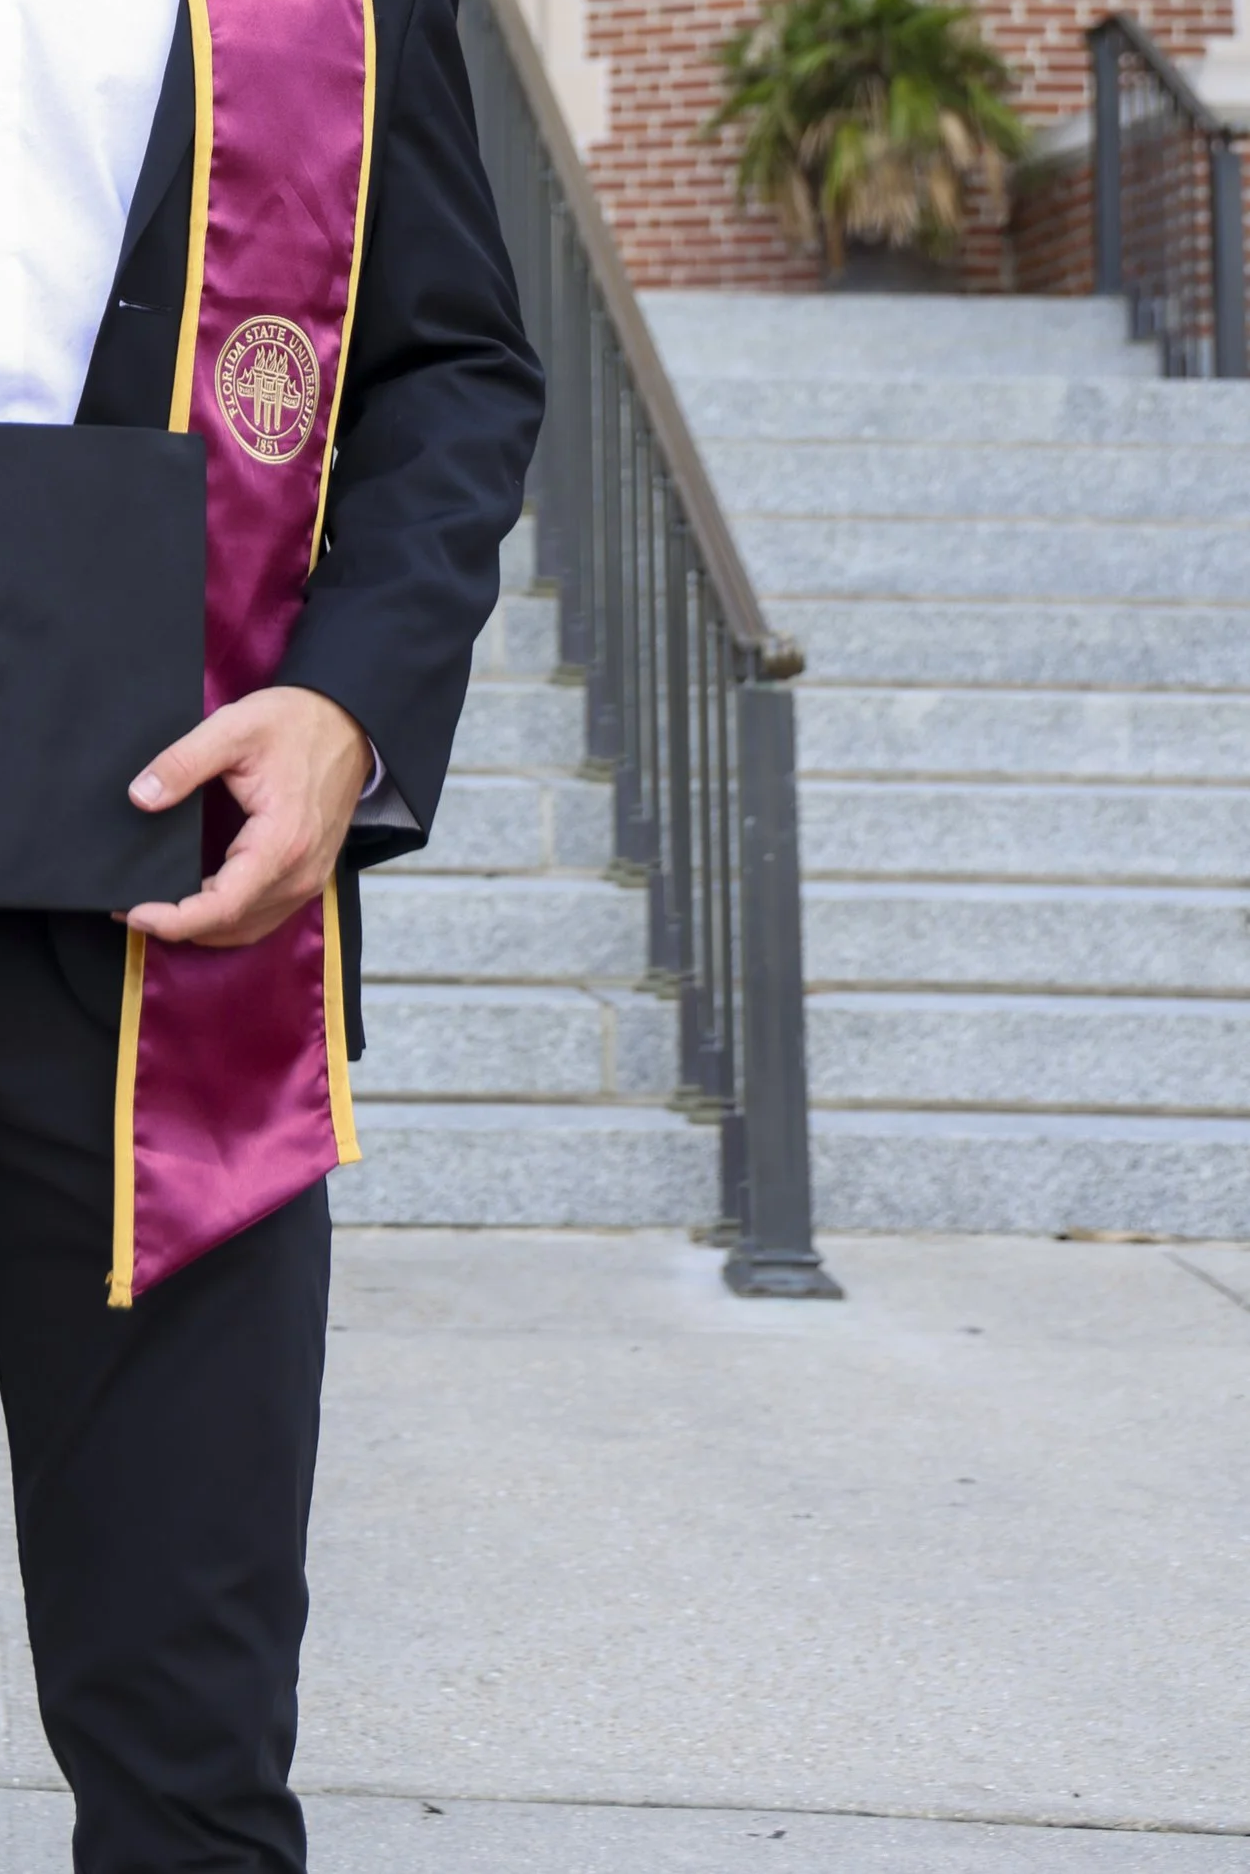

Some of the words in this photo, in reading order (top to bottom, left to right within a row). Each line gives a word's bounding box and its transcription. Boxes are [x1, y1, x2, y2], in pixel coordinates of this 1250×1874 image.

[222, 341, 246, 419] FLORIDA
[245, 325, 287, 342] STATE
[289, 334, 314, 437] UNIVERSITY
[254, 437, 280, 455] 1851
